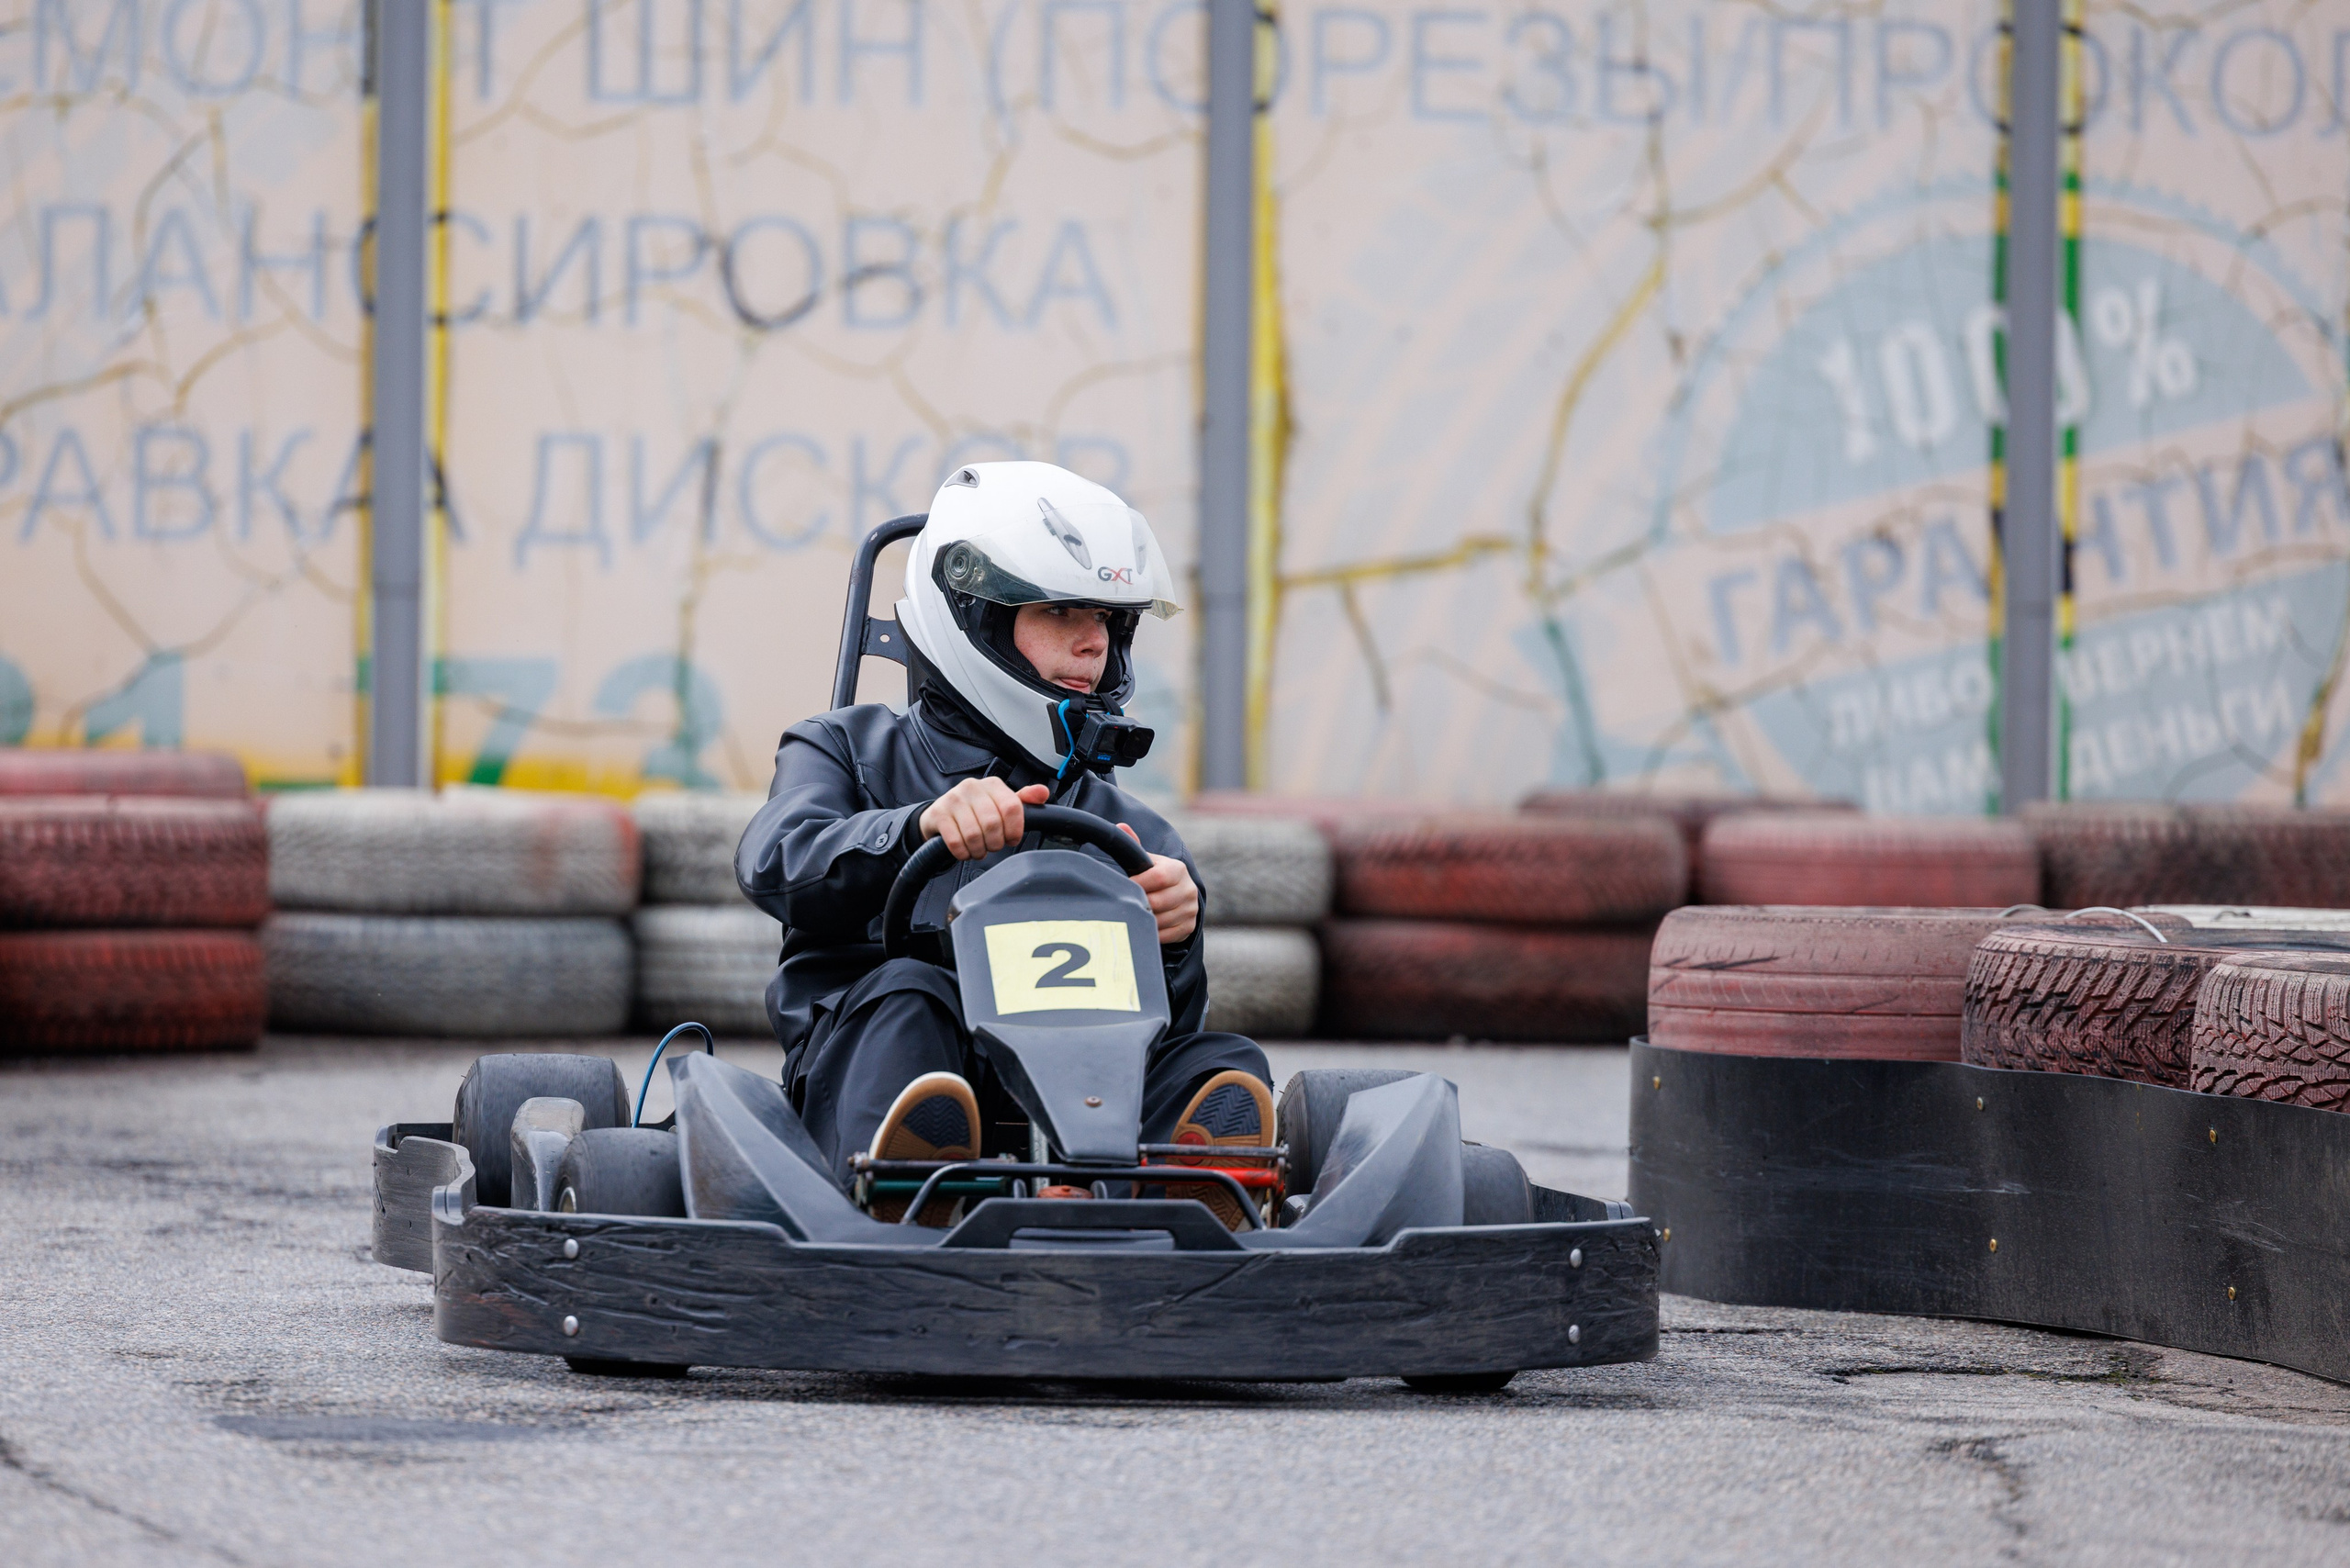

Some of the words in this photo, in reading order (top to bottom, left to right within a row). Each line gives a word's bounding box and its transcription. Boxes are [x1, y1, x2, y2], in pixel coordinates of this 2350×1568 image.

[586, 0, 925, 106] ШИН
[0, 202, 1120, 330] ЛАНСИРОВКА
[1818, 277, 2198, 465] 100%
[1097, 566, 1134, 585] GXT
[1707, 435, 2350, 668] ГАРАНТИЯ
[1031, 942, 1096, 989] 2
